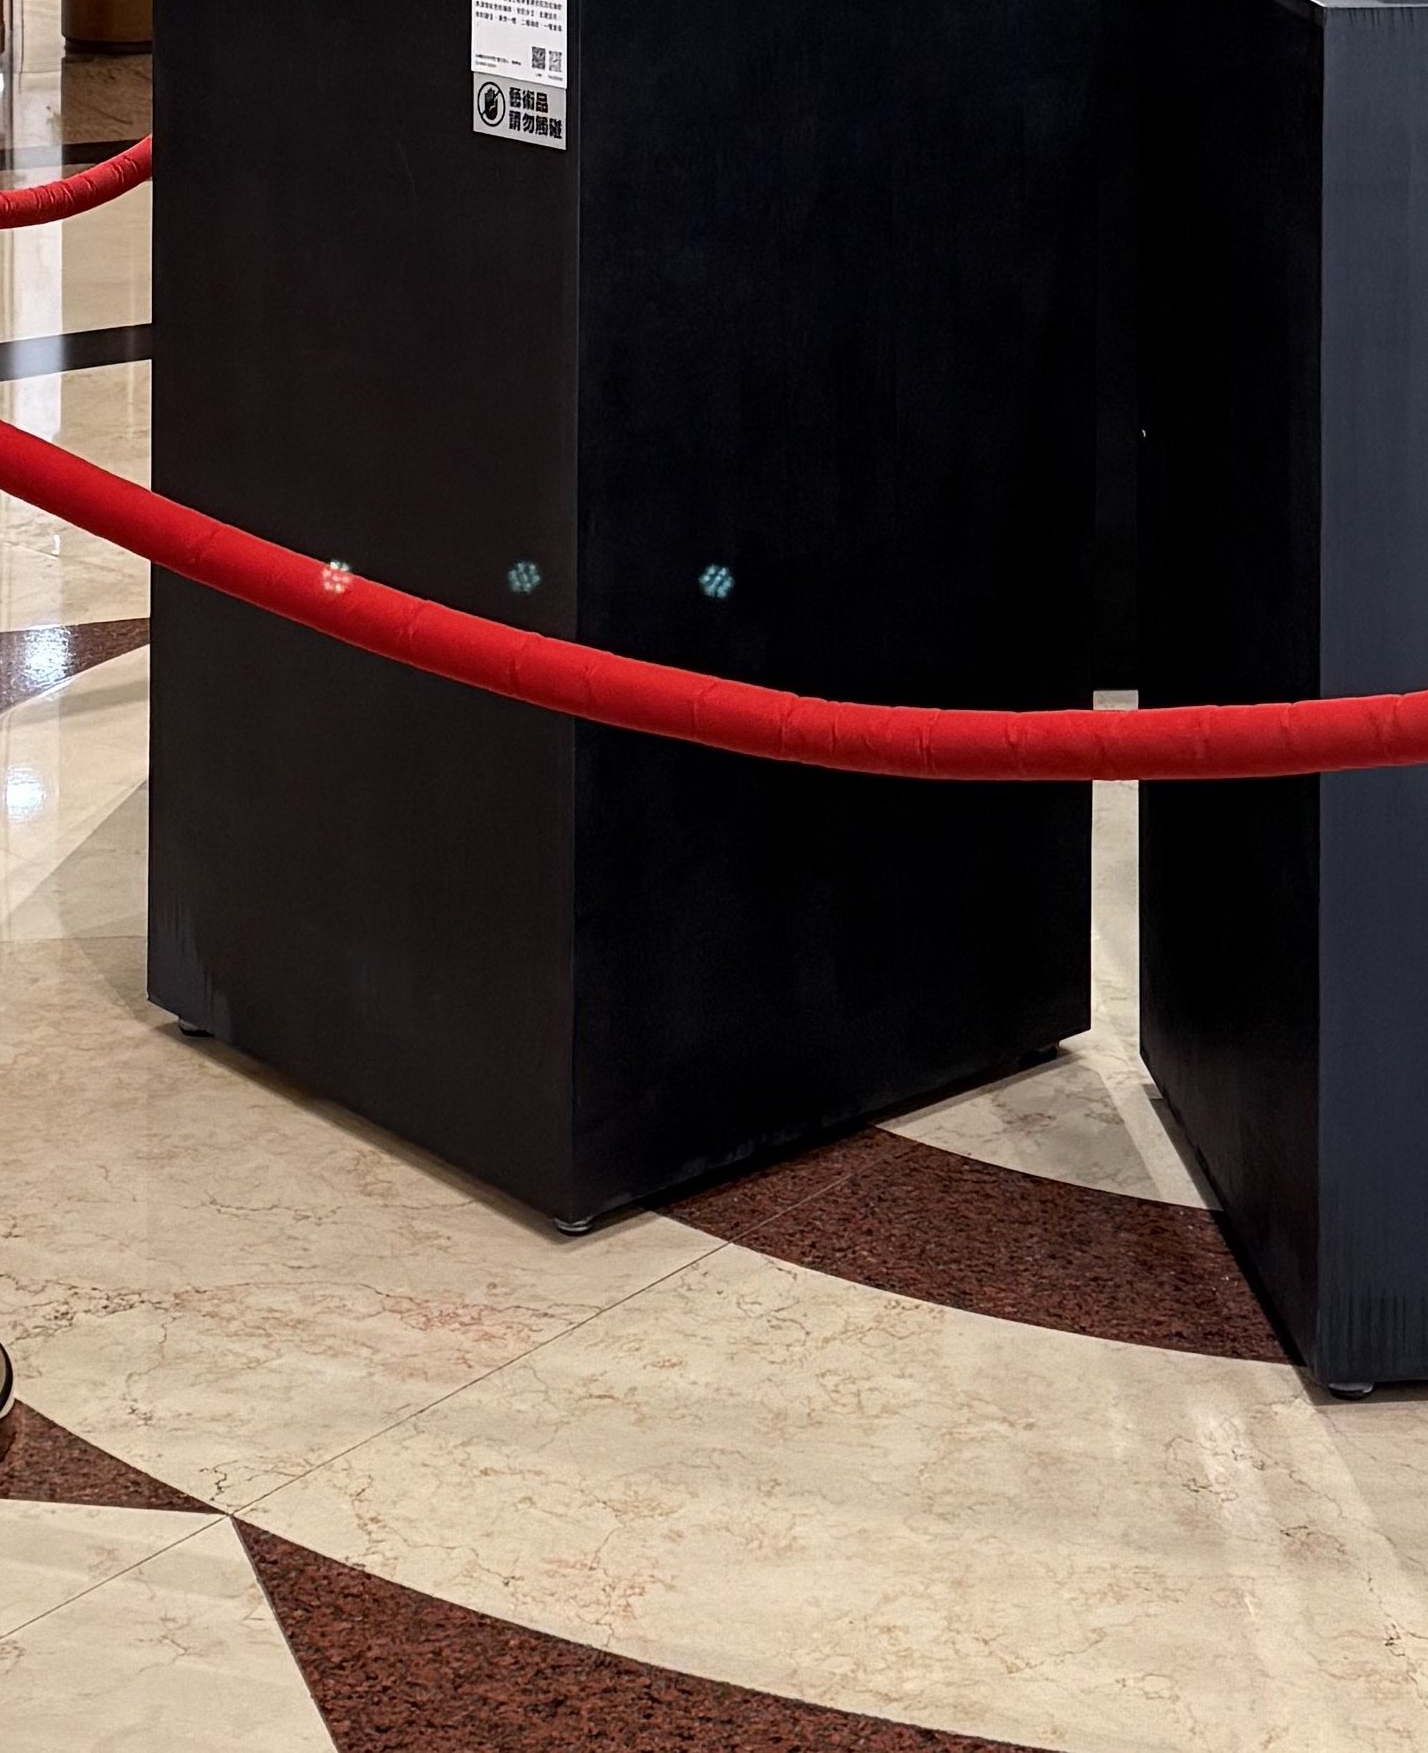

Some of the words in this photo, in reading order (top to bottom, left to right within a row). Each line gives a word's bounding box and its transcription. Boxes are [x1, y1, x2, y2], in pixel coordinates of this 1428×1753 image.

[509, 87, 548, 113] 藝術品
[508, 110, 562, 139] 請勿觸碰
